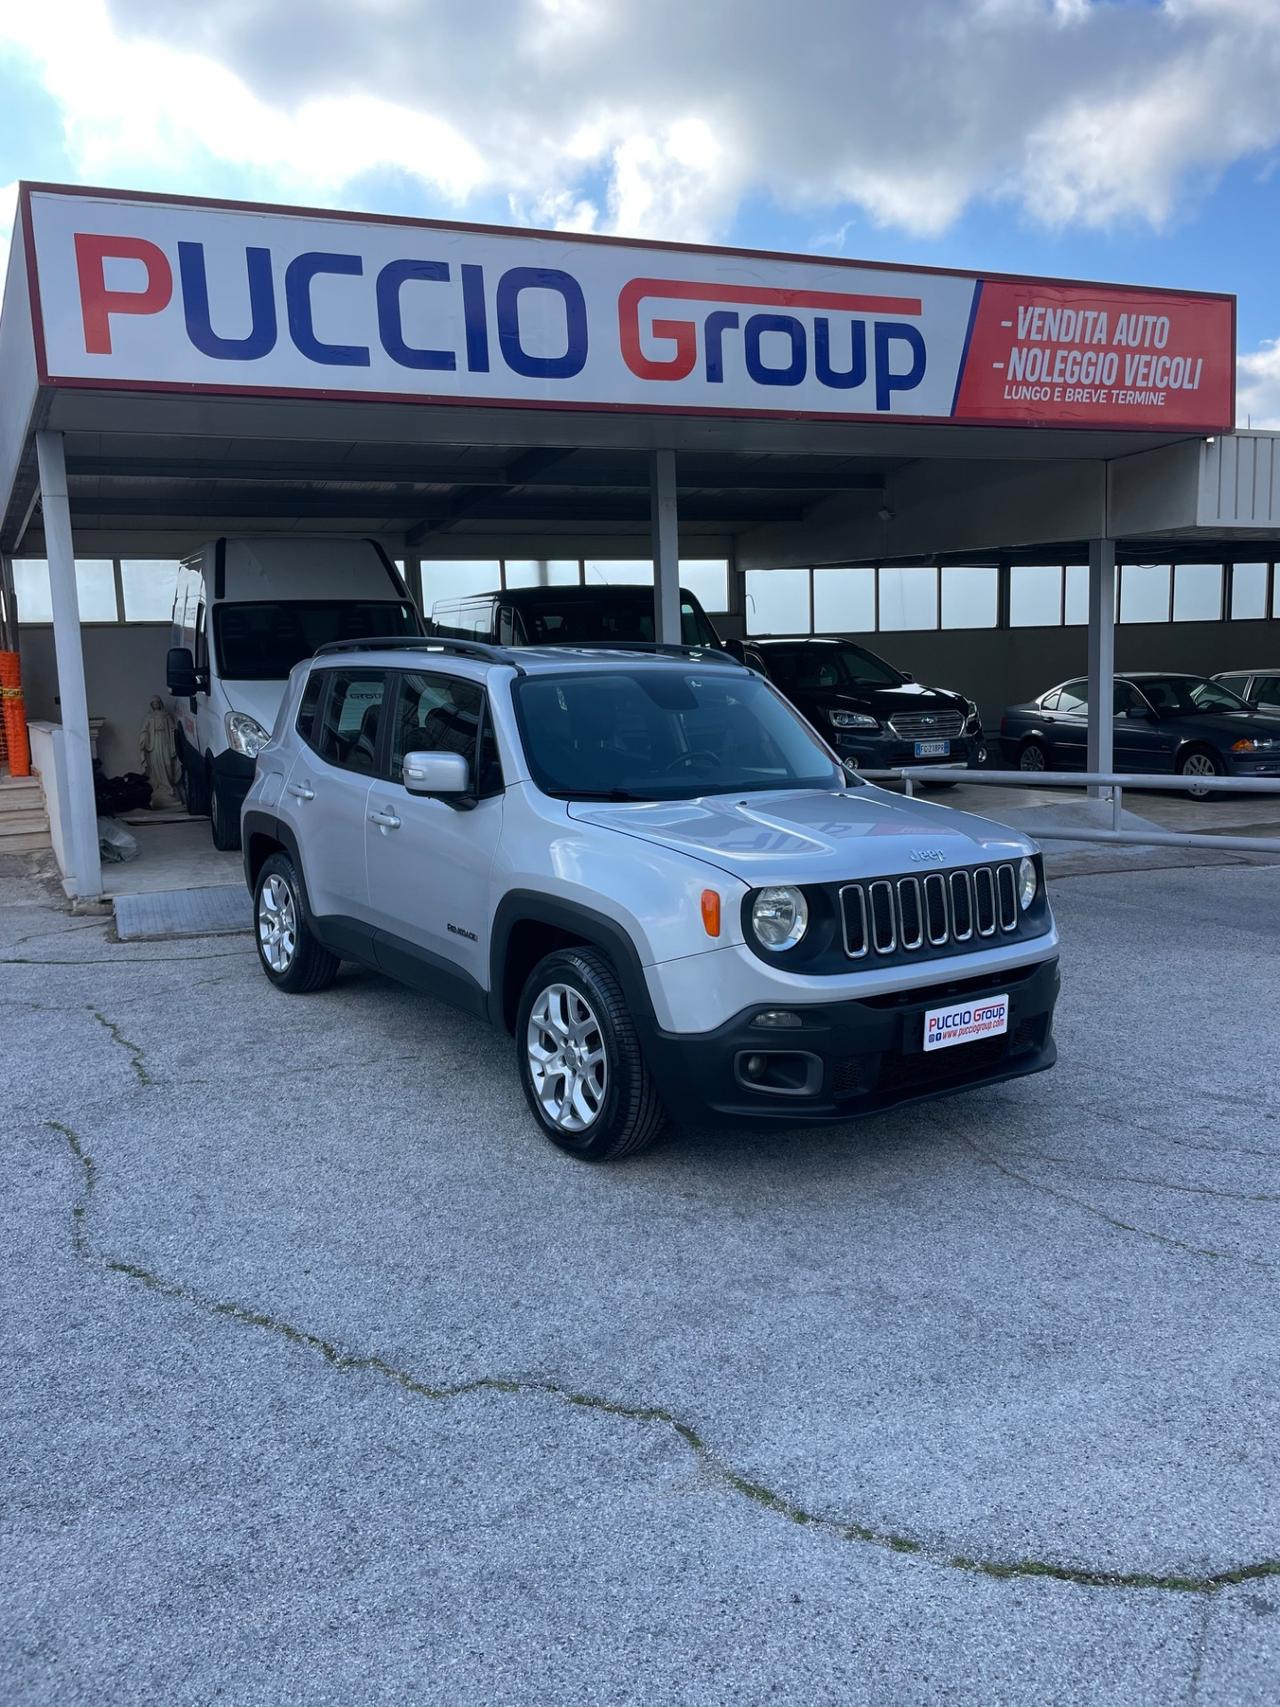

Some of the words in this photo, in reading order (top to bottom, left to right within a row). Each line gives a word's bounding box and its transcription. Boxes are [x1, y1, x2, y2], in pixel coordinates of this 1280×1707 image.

[74, 232, 588, 379] PUCCIO
[618, 277, 926, 411] Group
[1112, 313, 1170, 349] AUTO
[1124, 353, 1203, 390] VEICOLI
[1004, 385, 1050, 401] LUNGO
[1053, 387, 1063, 402] E
[1065, 388, 1108, 404] BREVE
[1111, 389, 1166, 406] TERMINE
[910, 848, 944, 863] Jeep
[929, 1010, 972, 1032] PUCCIO
[973, 1003, 1005, 1022] Group
[942, 1018, 1005, 1038] www.pucciogroup.com
